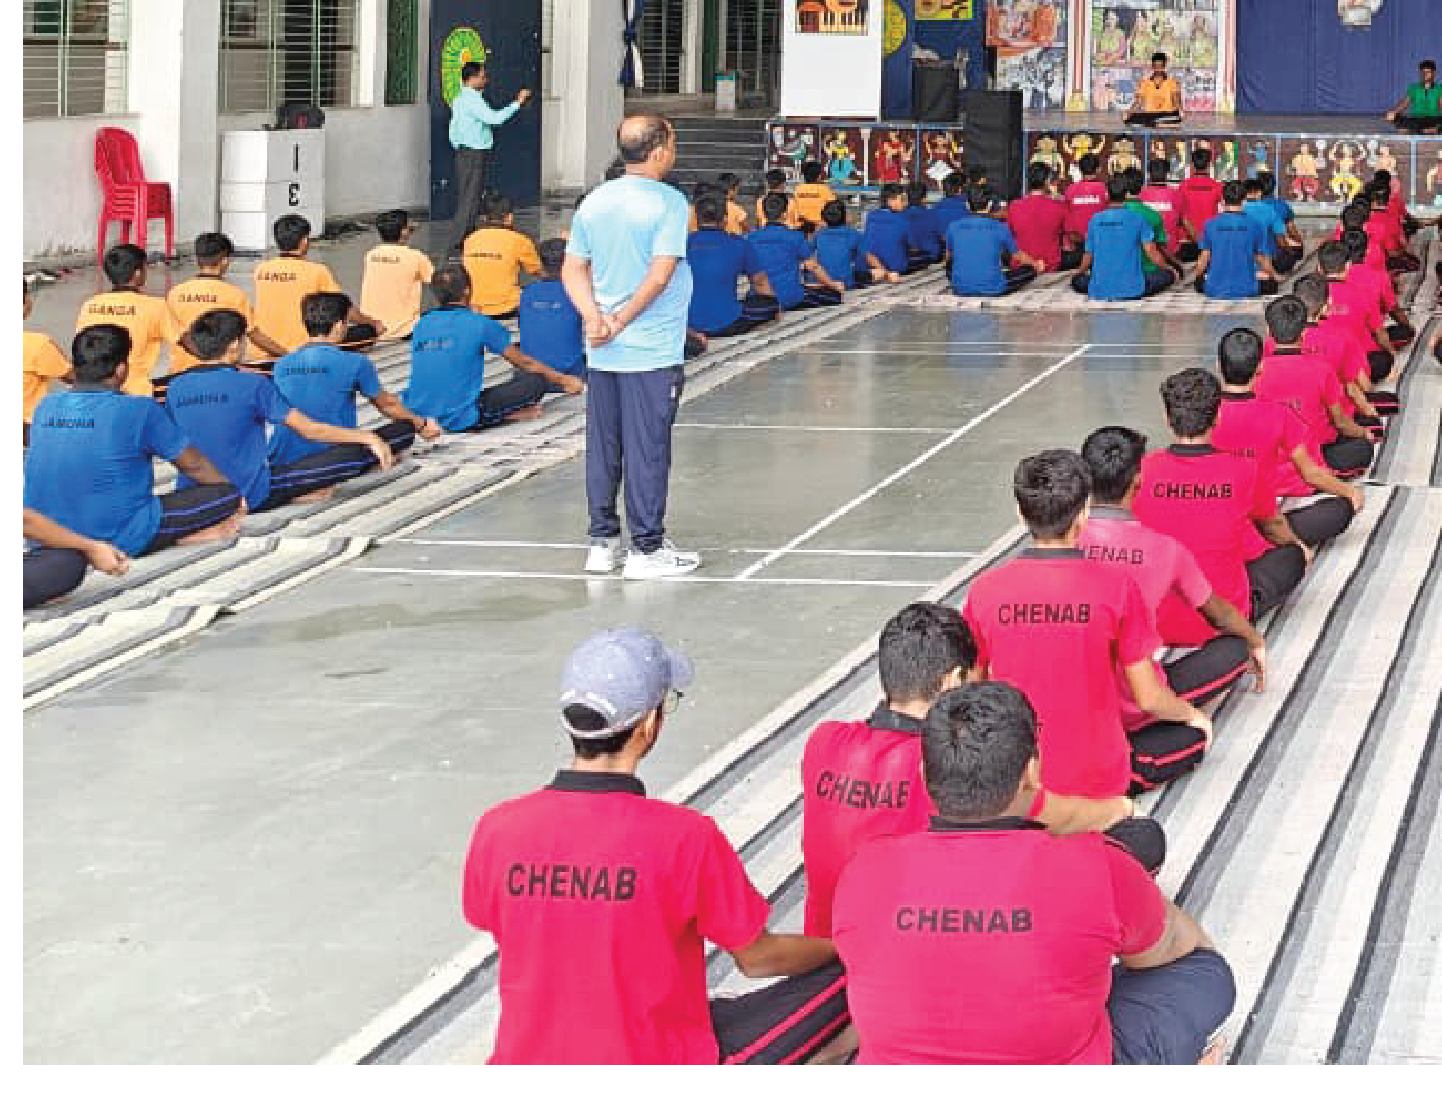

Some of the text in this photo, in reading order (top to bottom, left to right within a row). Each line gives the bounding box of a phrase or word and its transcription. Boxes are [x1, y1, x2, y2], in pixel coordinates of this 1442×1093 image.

[1153, 483, 1233, 498] CHENAB
[1084, 545, 1144, 565] ENAB
[998, 603, 1091, 624] CHENAB
[507, 862, 637, 902] CHENAB
[896, 906, 1034, 933] CHENAB
